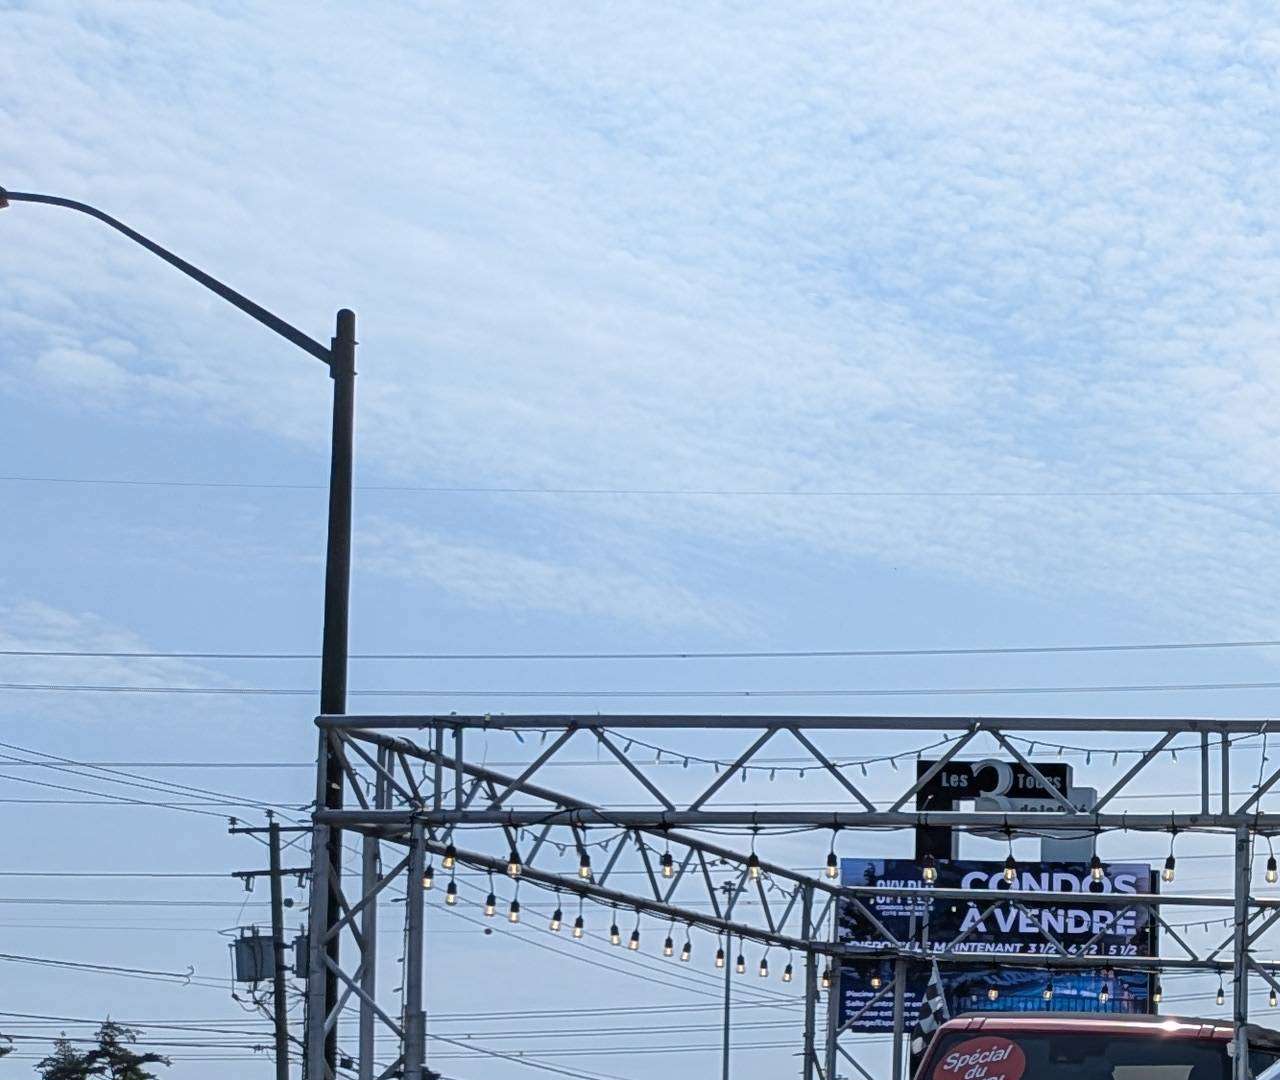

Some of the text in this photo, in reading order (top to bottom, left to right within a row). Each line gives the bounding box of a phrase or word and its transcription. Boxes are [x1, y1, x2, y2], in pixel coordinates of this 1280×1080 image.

[941, 771, 969, 788] Les
[960, 870, 1138, 895] CONDOS
[958, 900, 1138, 936] À VENDRE
[933, 941, 1024, 955] MINTENANT
[943, 1043, 1014, 1073] Spécial
[964, 1064, 988, 1080] du
